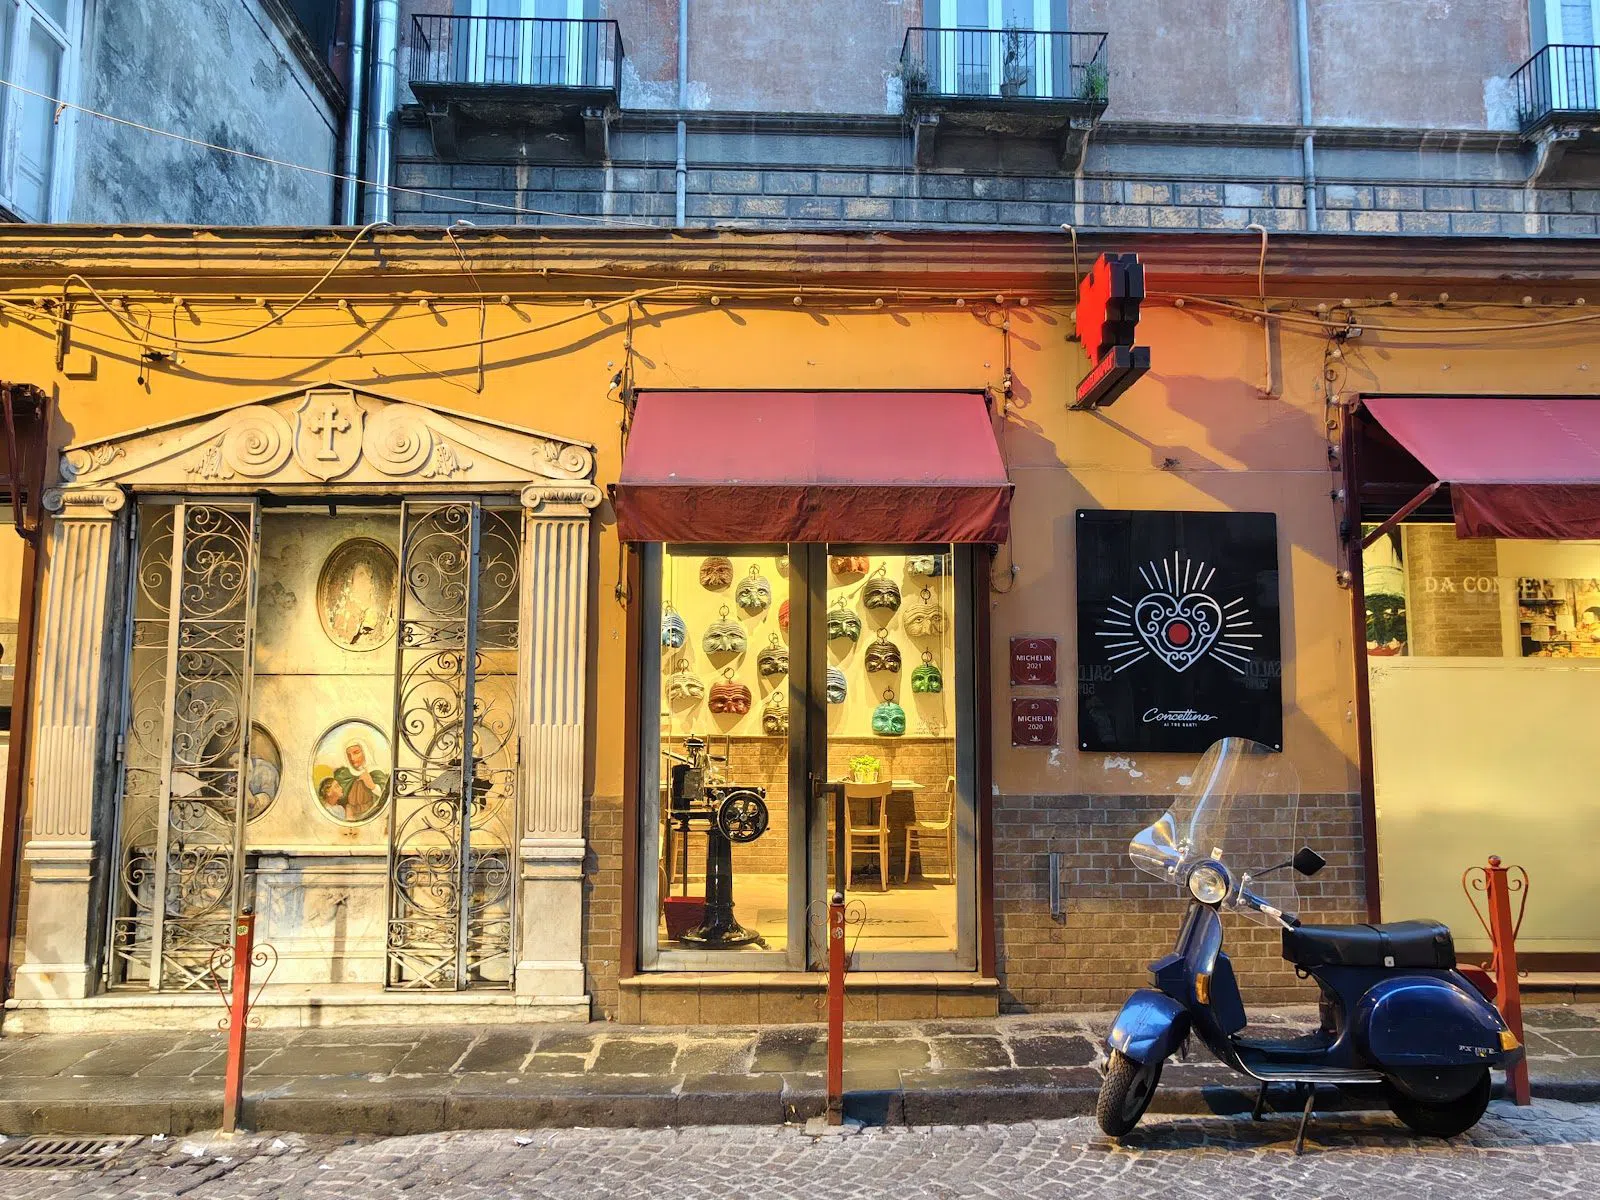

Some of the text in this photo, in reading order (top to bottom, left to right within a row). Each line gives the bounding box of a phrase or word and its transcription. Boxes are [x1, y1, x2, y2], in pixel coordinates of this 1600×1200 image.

[1424, 576, 1456, 593] DA
[1016, 654, 1052, 662] MICHELIN
[1142, 707, 1219, 723] Concettina
